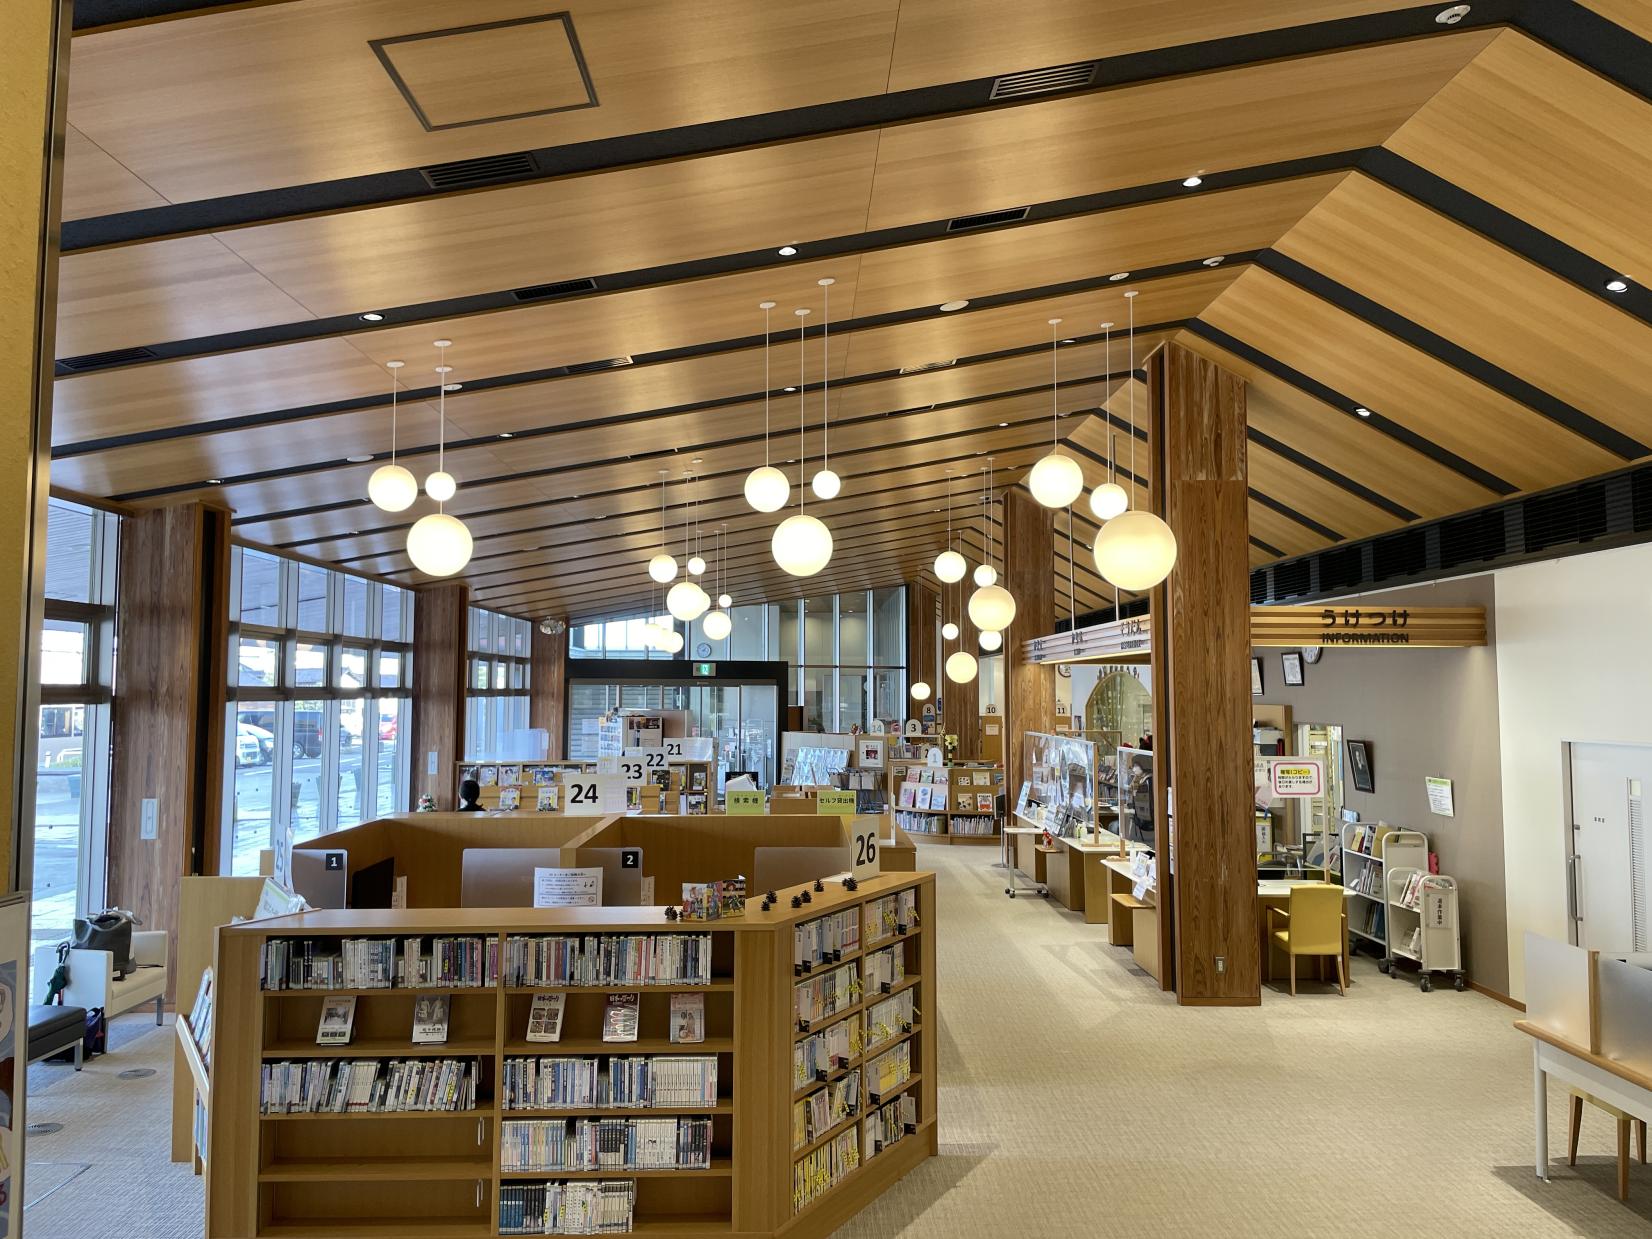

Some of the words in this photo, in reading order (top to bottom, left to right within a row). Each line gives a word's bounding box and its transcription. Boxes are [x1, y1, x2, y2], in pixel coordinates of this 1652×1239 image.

[1321, 609, 1410, 629] うけつけ
[1321, 632, 1409, 644] INFORMATION
[926, 706, 931, 714] 8
[987, 706, 996, 714] 10
[910, 723, 917, 732] 3
[666, 743, 683, 756] 21
[646, 753, 665, 767] 22
[621, 763, 643, 780] 23
[570, 783, 599, 804] 24
[855, 832, 876, 867] 26
[330, 856, 338, 867] 1
[626, 854, 634, 865] 2
